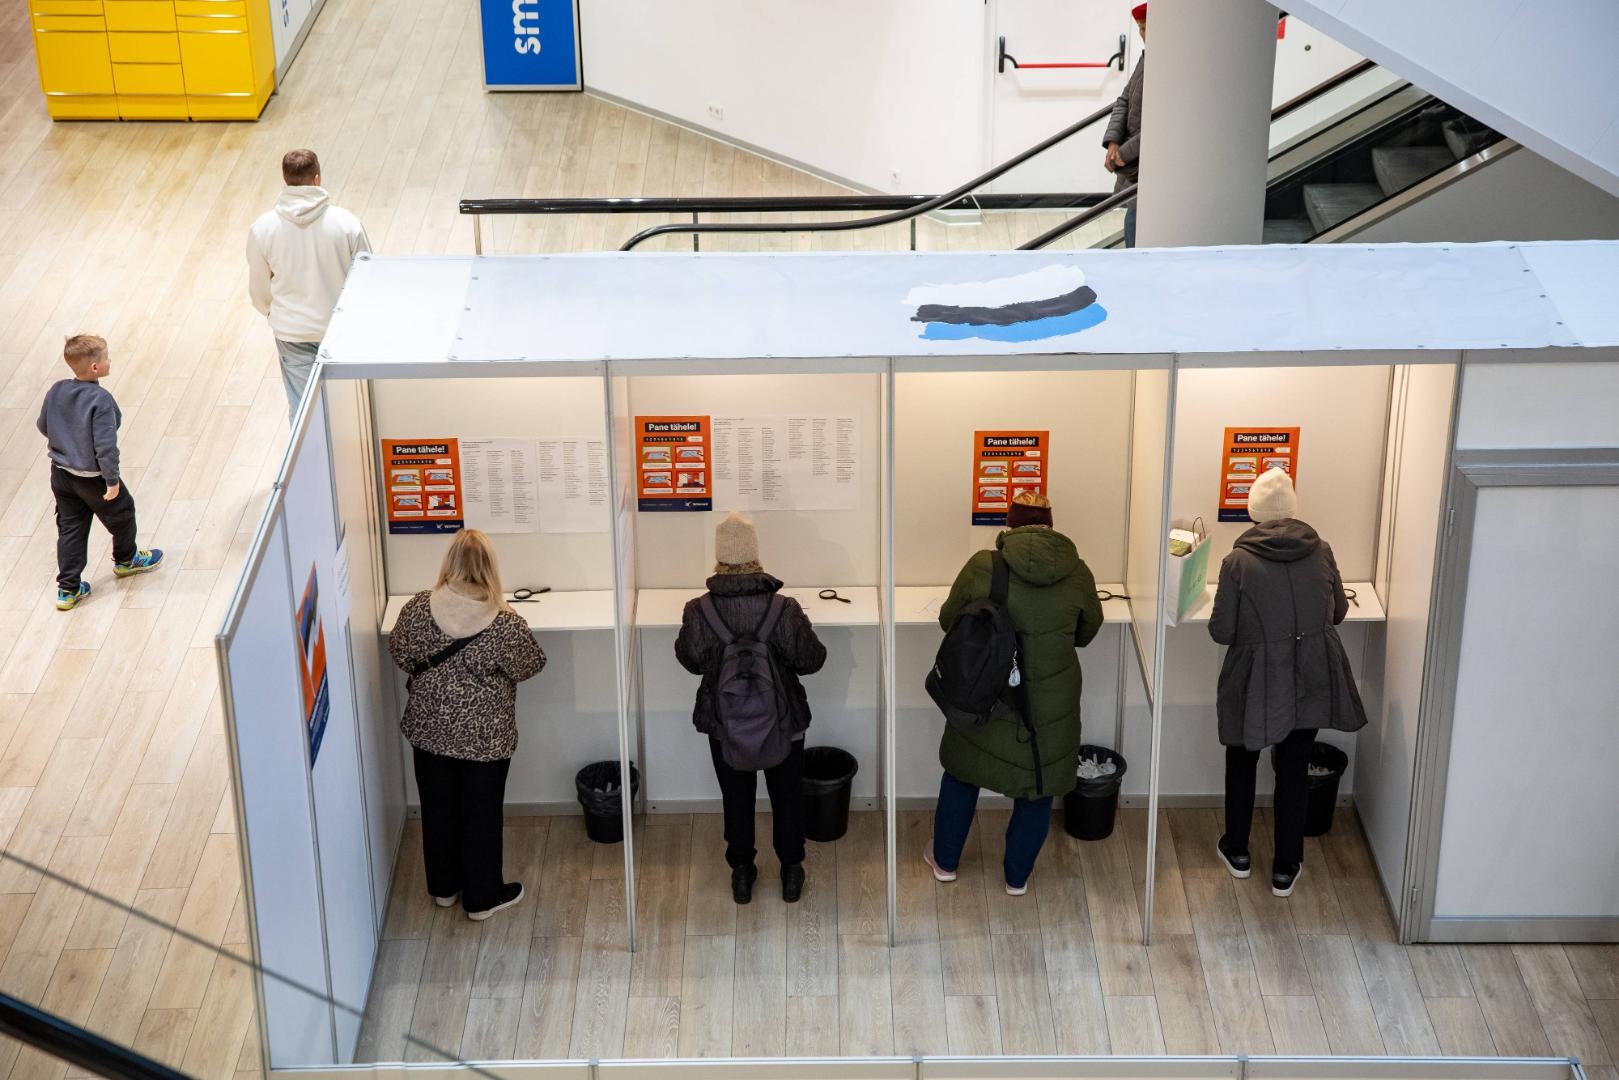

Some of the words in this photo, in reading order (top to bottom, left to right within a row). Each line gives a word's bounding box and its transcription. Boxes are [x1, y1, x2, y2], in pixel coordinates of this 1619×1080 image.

[648, 423, 669, 431] Pane
[670, 423, 697, 431] tähele!
[987, 438, 1008, 446] Pane
[1009, 437, 1036, 446] tähele!
[1237, 434, 1258, 442] Pane
[1259, 434, 1287, 442] tähele!
[396, 446, 417, 454] Pane
[417, 445, 445, 453] tähele!
